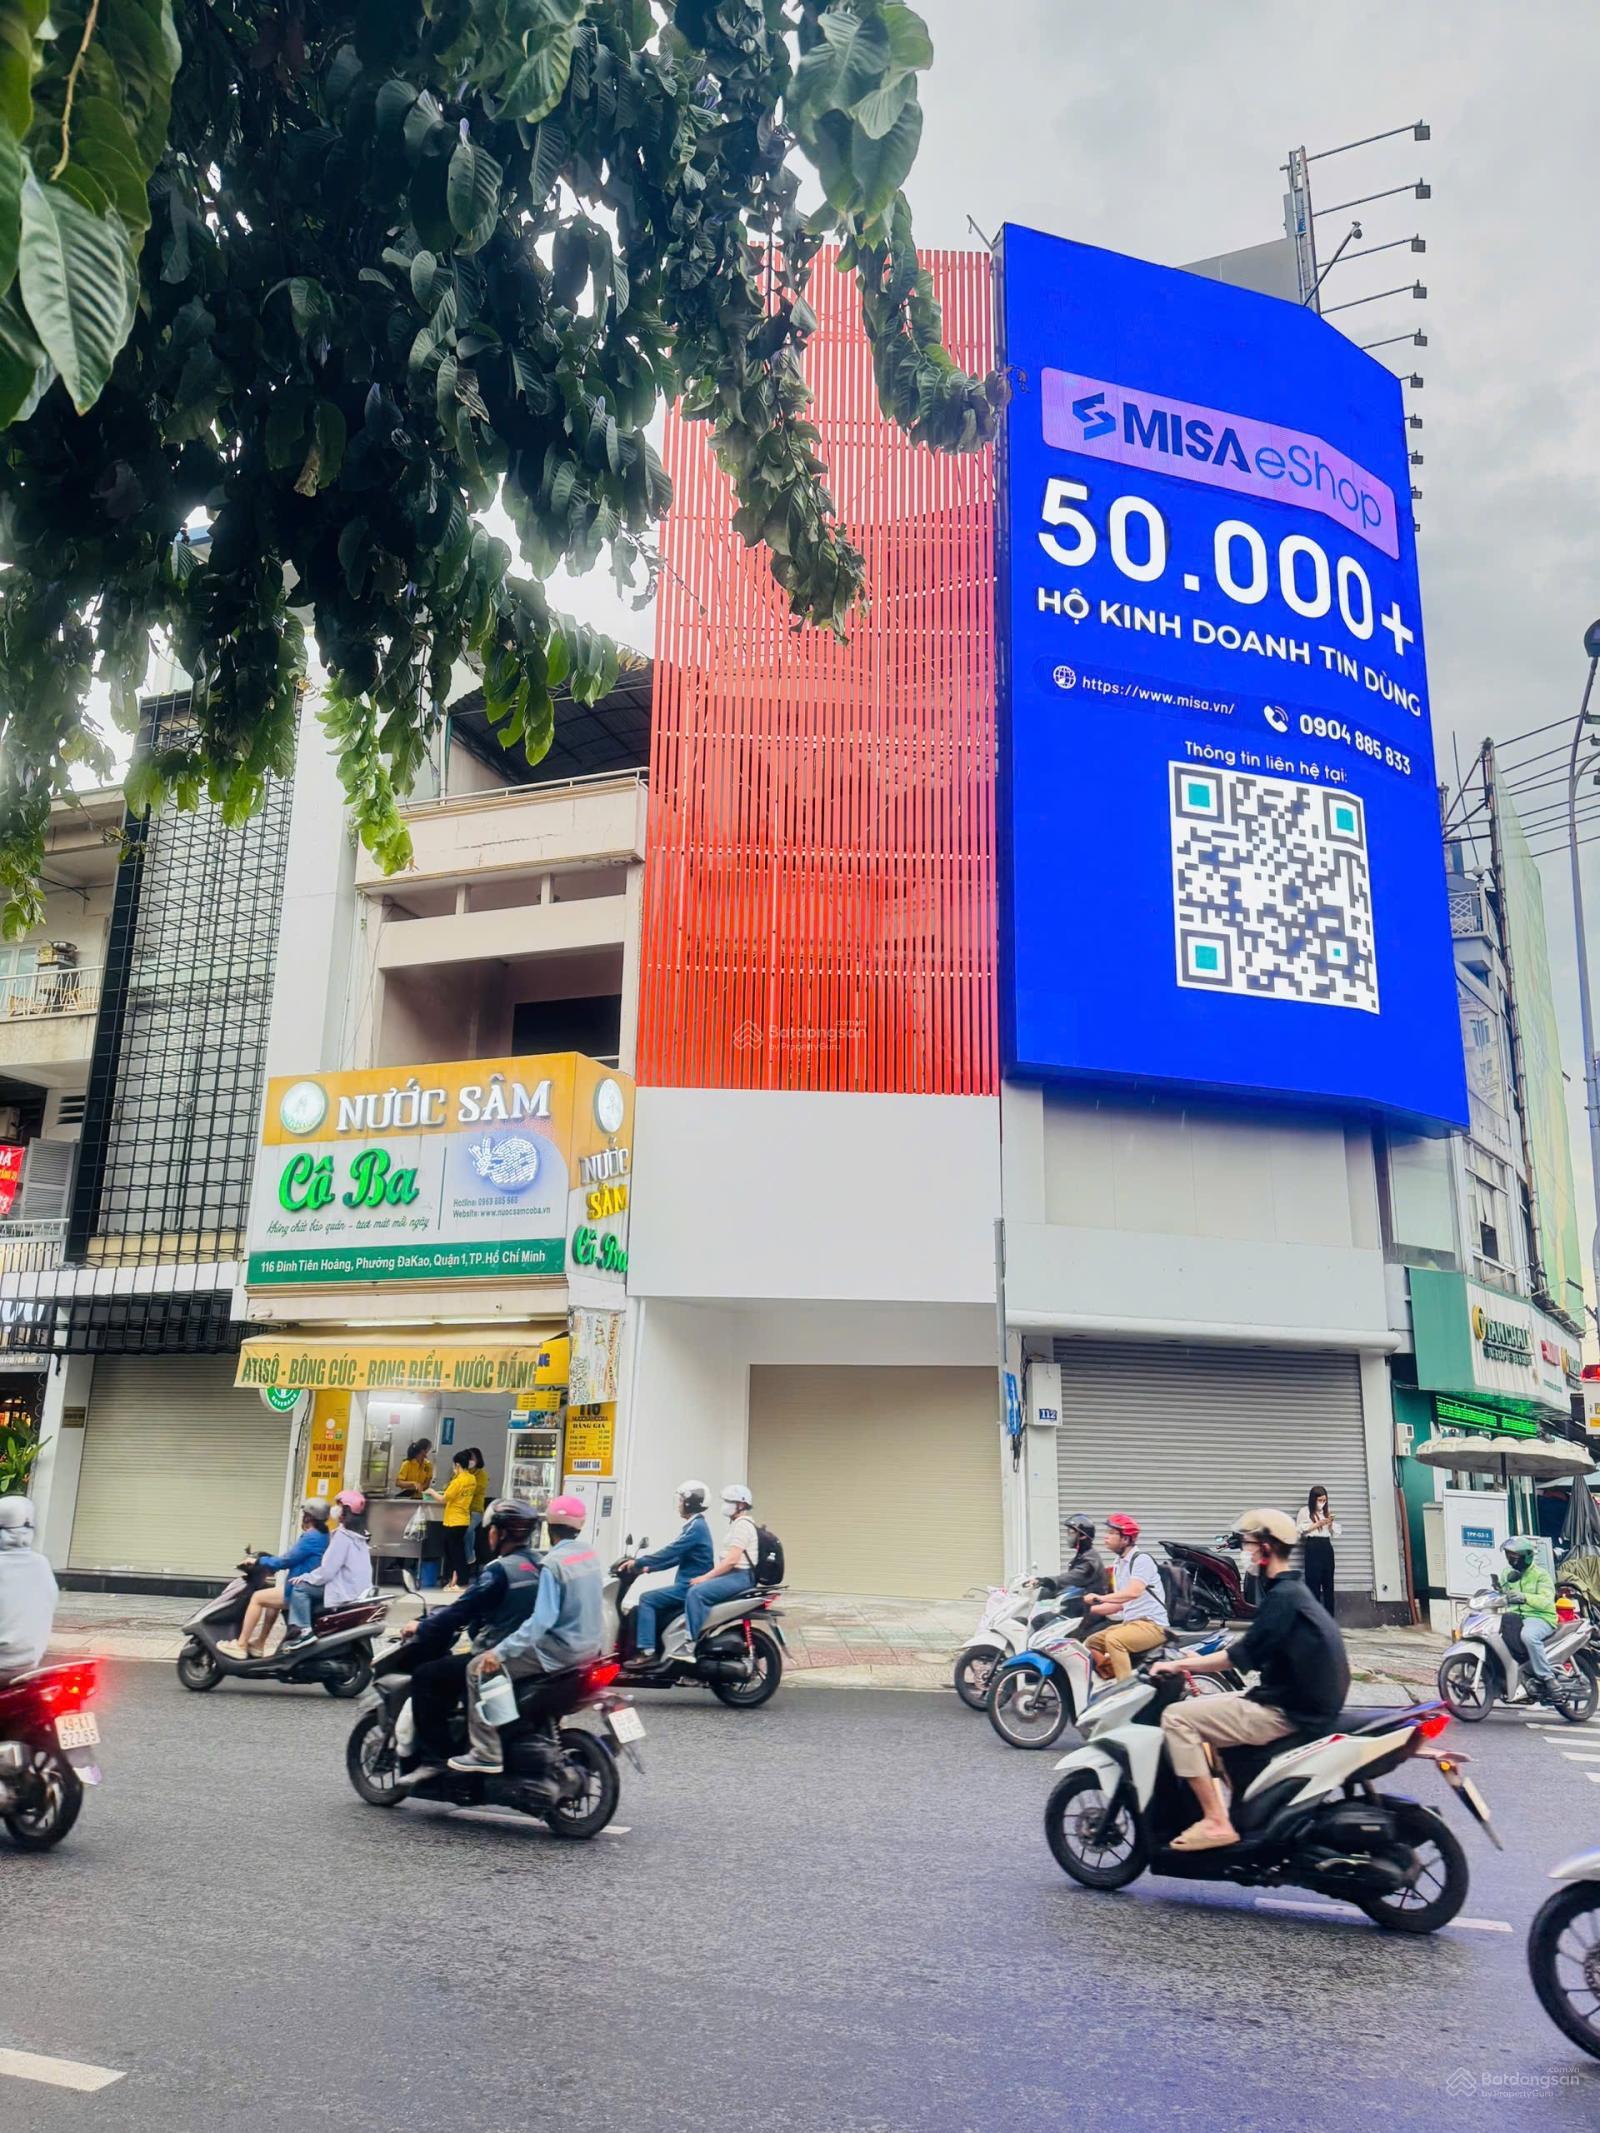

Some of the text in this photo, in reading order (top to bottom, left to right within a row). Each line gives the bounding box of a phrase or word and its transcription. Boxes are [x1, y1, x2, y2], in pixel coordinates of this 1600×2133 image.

[1123, 401, 1382, 528] MISA eShop
[1038, 477, 1415, 656] 50.000+
[1037, 587, 1422, 717] HỘ KINH DOANH TIN DÙNG
[1081, 675, 1235, 716] https://www.misa.vn/
[1184, 740, 1348, 785] Thông tin liên hệ tại:
[1299, 713, 1411, 776] 0904 885 833
[336, 1072, 552, 1132] NƯỚC SÂM
[278, 1147, 420, 1212] Cô Ba
[579, 1136, 629, 1184] NƯỚC
[261, 1261, 275, 1272] 116
[298, 1258, 319, 1271] Tiên
[321, 1258, 354, 1273] Hoàng,
[356, 1255, 395, 1270] Phường
[502, 1247, 520, 1263] Chí
[521, 1249, 546, 1262] Minh
[241, 1354, 280, 1384] ATISÔ
[288, 1354, 326, 1384] BÔNG
[328, 1353, 356, 1385] CÚC
[368, 1360, 405, 1386] RONG
[408, 1348, 442, 1387] BIỂN
[454, 1354, 494, 1388] NƯỚC
[497, 1352, 537, 1389] ĐẮNG
[1041, 1409, 1056, 1419] 112
